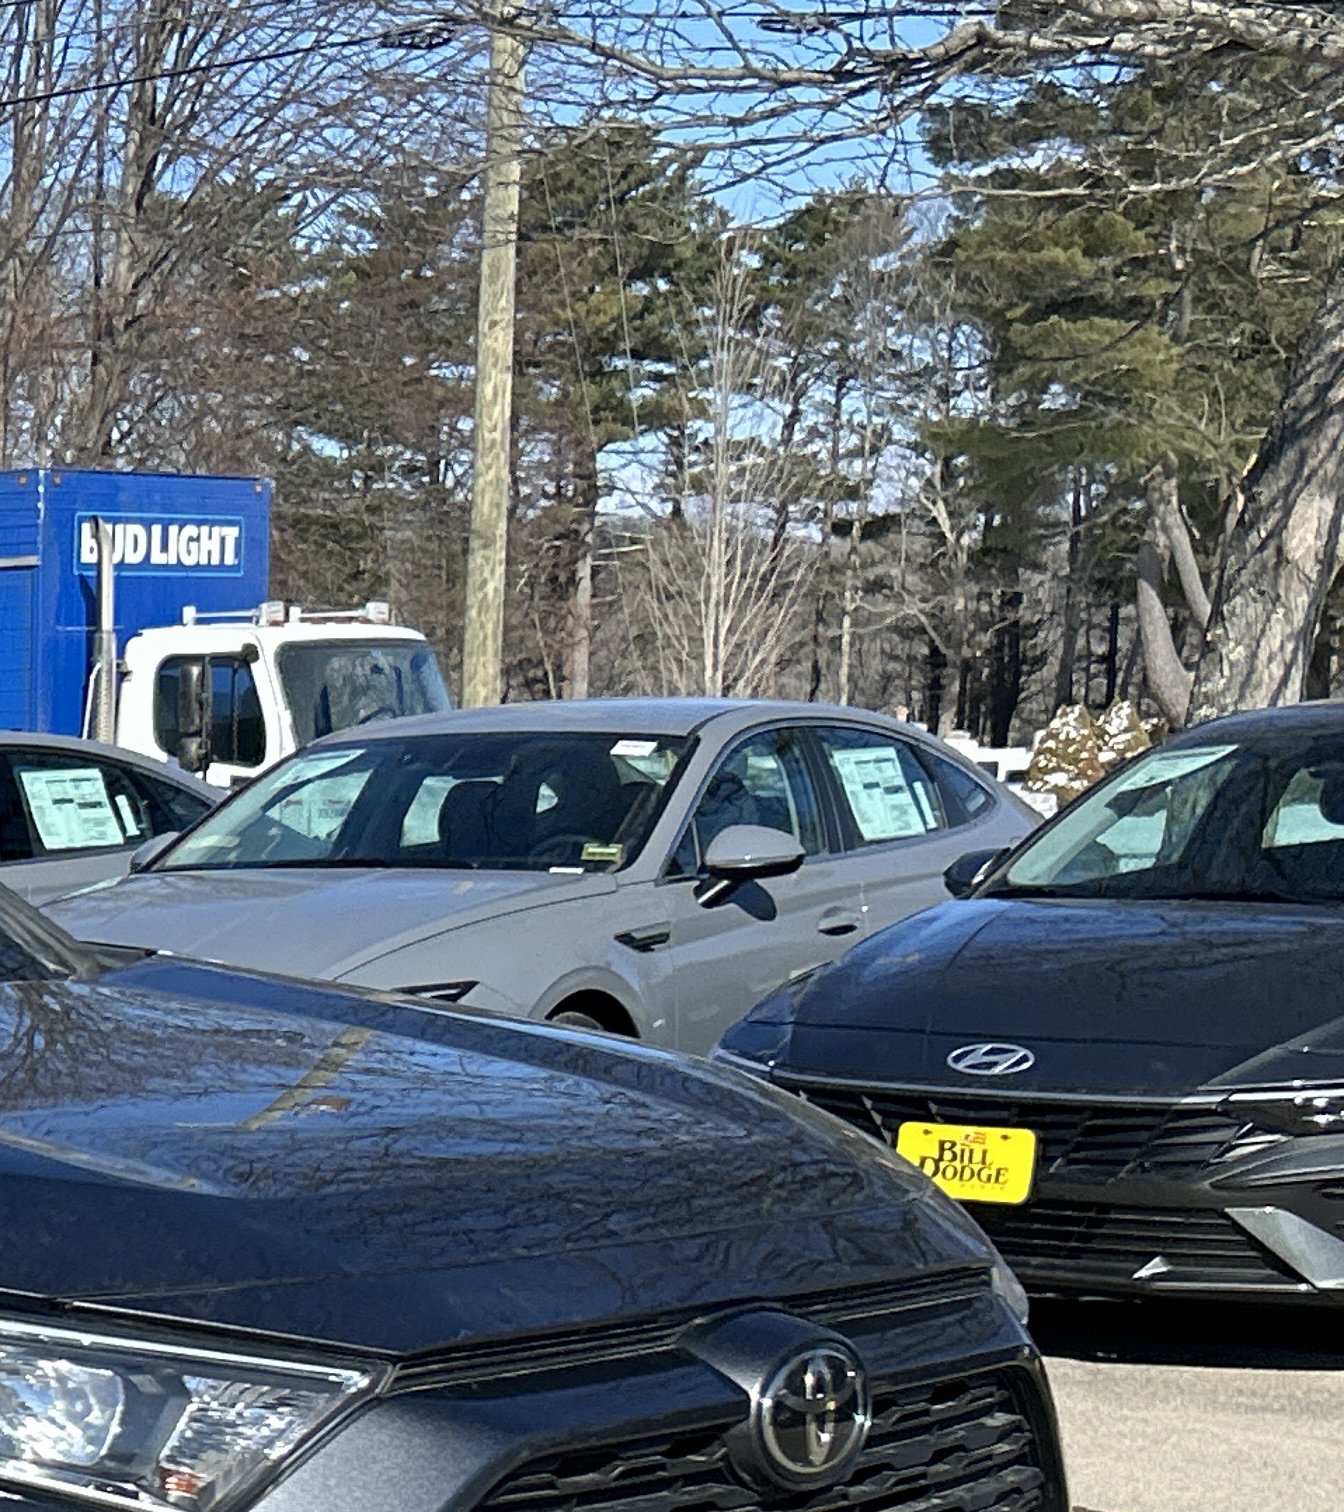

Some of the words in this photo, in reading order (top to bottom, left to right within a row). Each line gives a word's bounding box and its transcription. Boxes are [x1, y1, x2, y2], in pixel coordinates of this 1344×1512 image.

[80, 522, 147, 565] BUD
[150, 524, 240, 566] LIGHT
[937, 1139, 992, 1165] BILL
[919, 1155, 1009, 1184] DODGE
